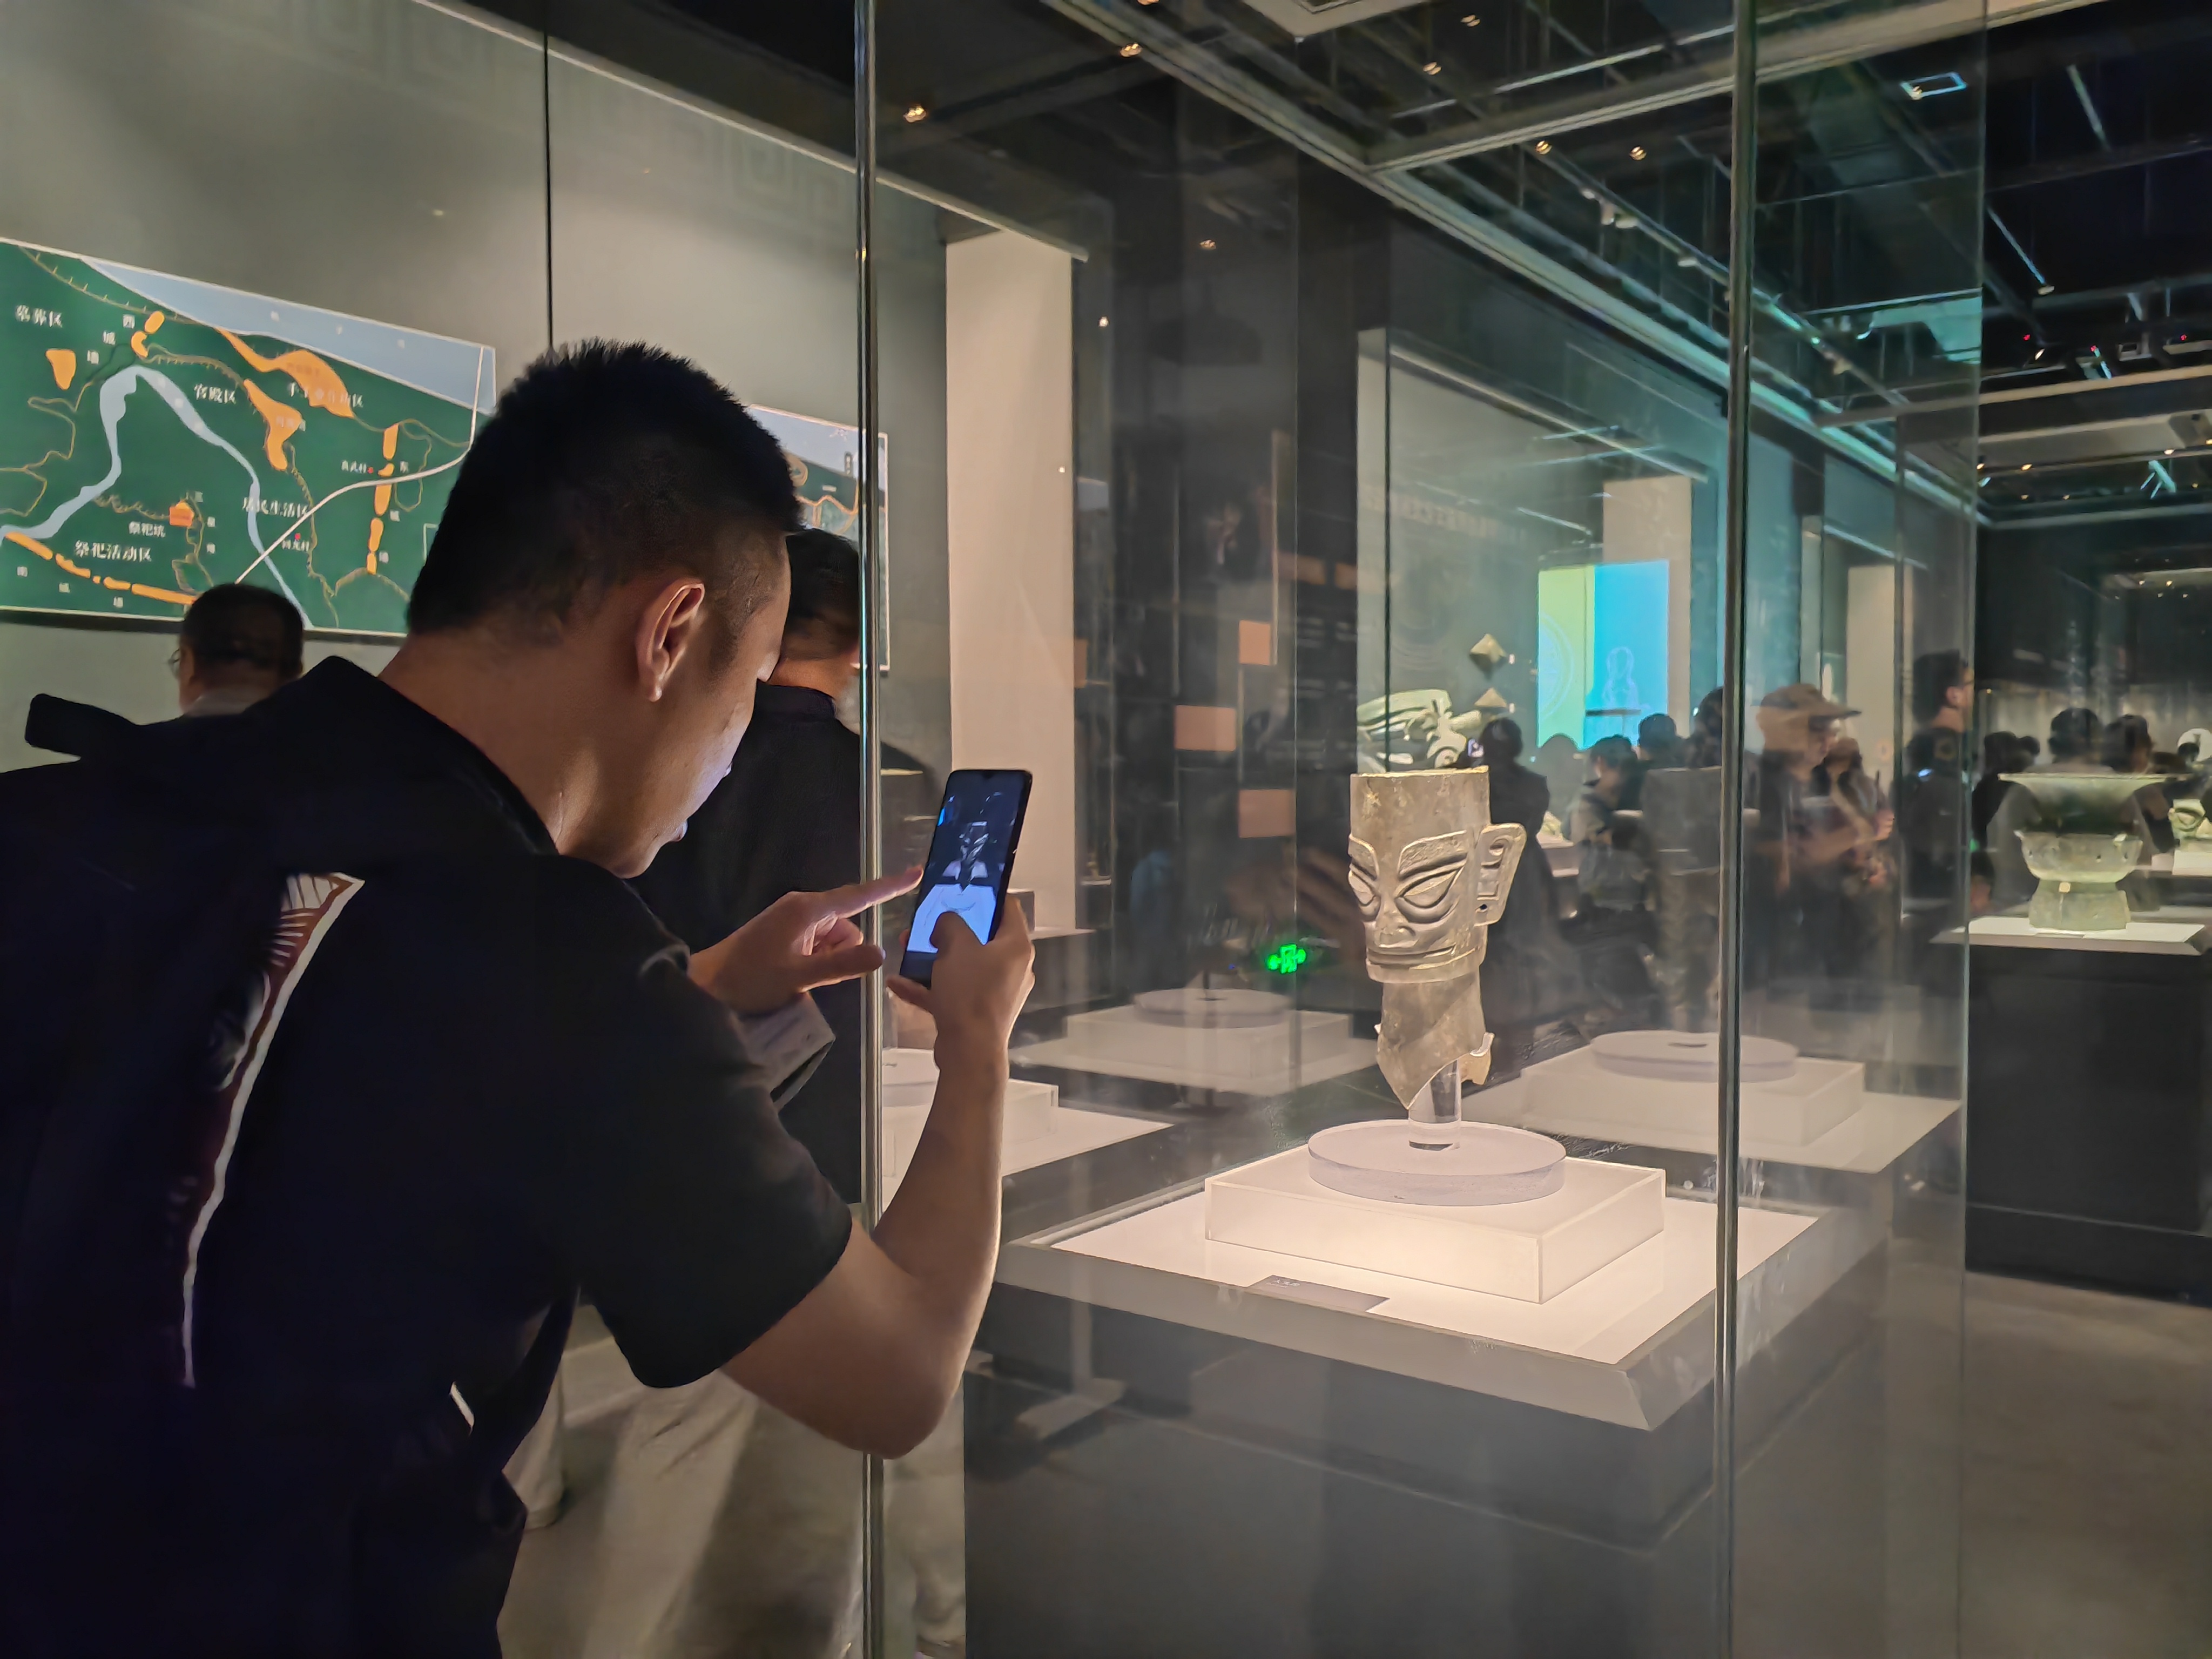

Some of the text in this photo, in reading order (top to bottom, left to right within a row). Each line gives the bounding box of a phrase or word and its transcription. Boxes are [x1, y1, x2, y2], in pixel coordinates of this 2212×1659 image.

[75, 539, 153, 563] 祭祀活动区
